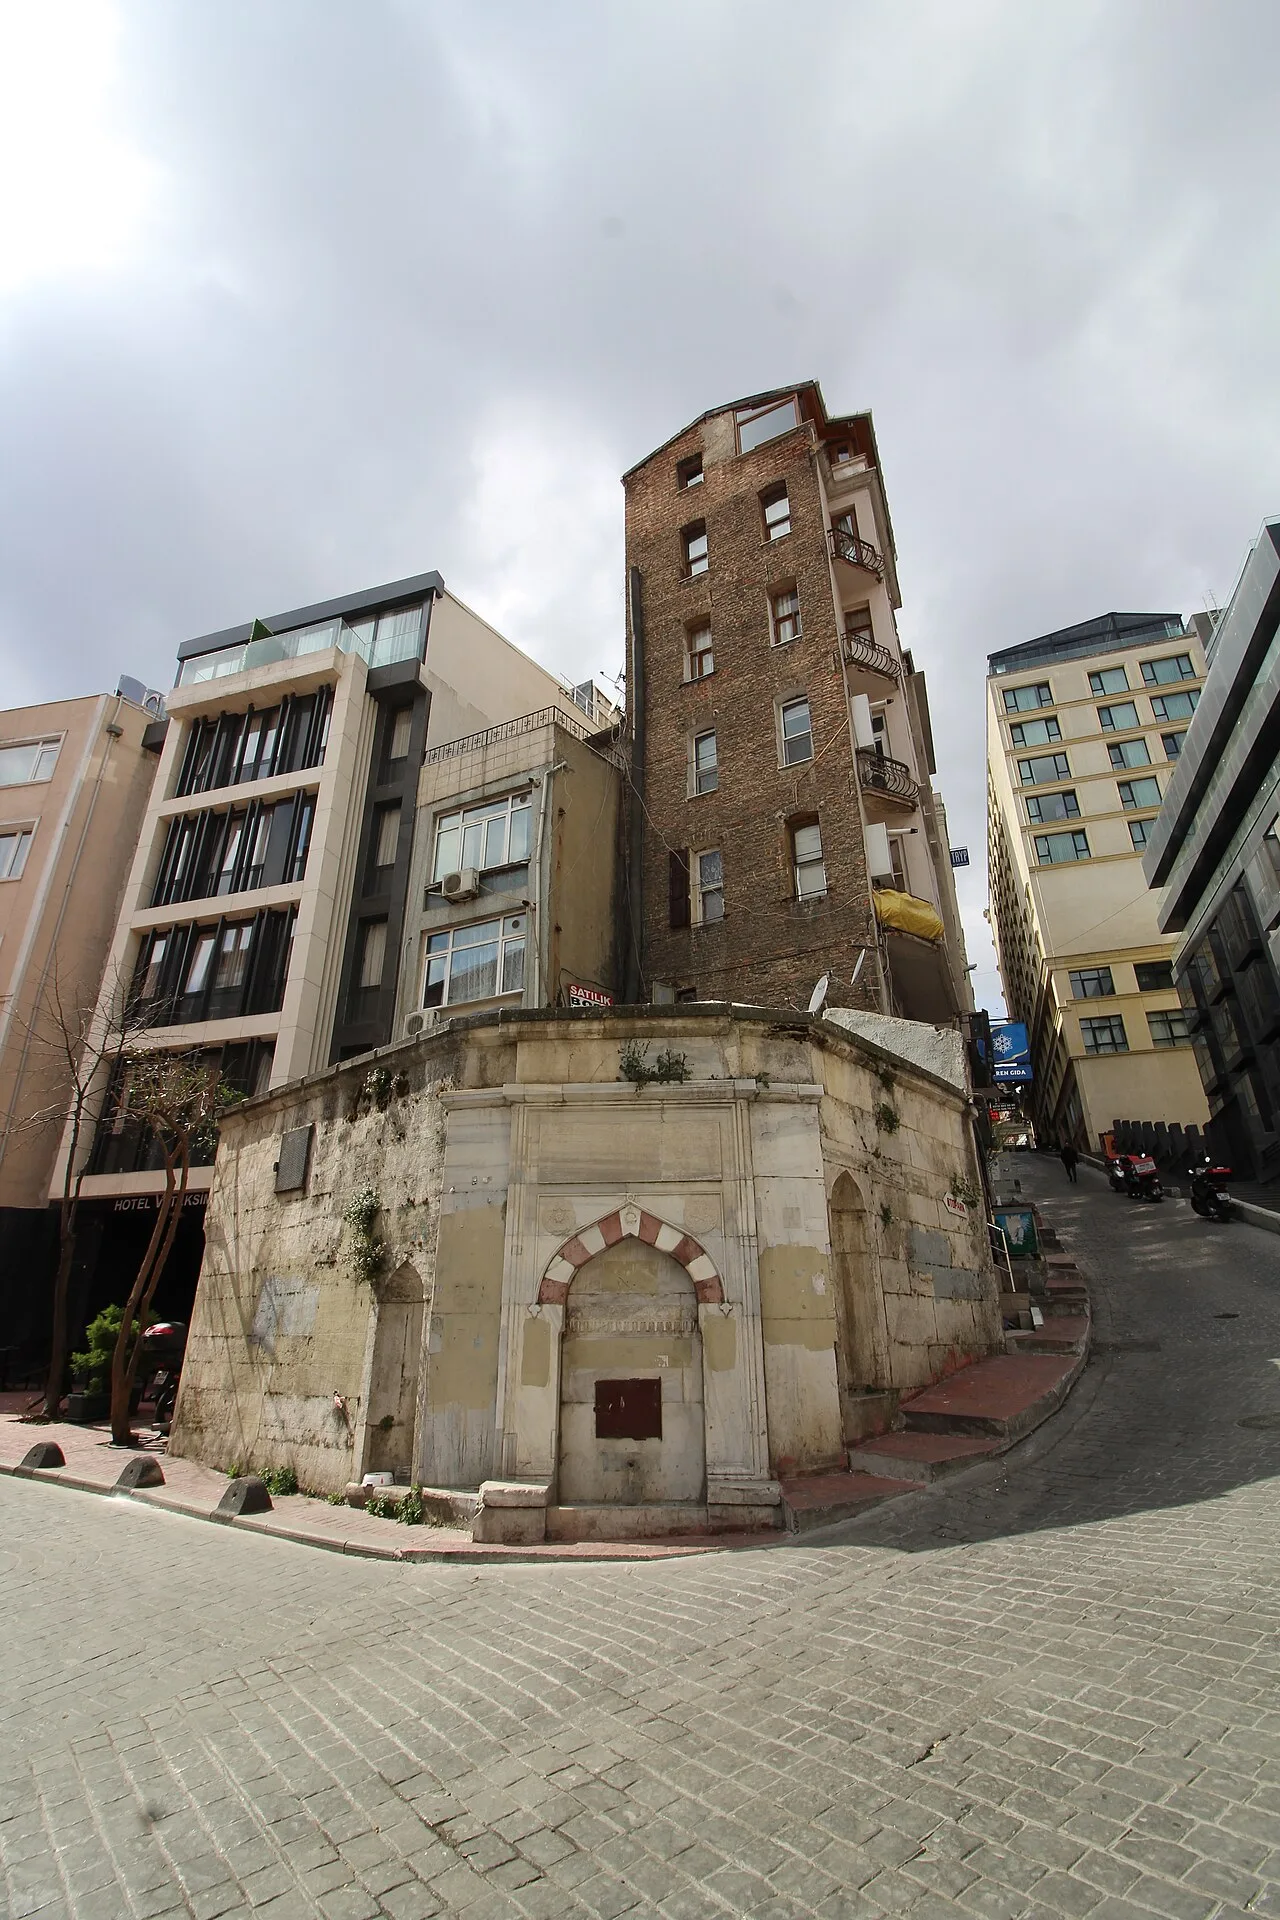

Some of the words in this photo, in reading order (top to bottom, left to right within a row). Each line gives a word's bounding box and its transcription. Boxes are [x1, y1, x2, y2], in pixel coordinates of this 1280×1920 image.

[951, 850, 968, 863] TRYP
[570, 985, 611, 1006] SATILIK
[571, 996, 602, 1008] BO
[114, 1198, 151, 1211] HOTEL
